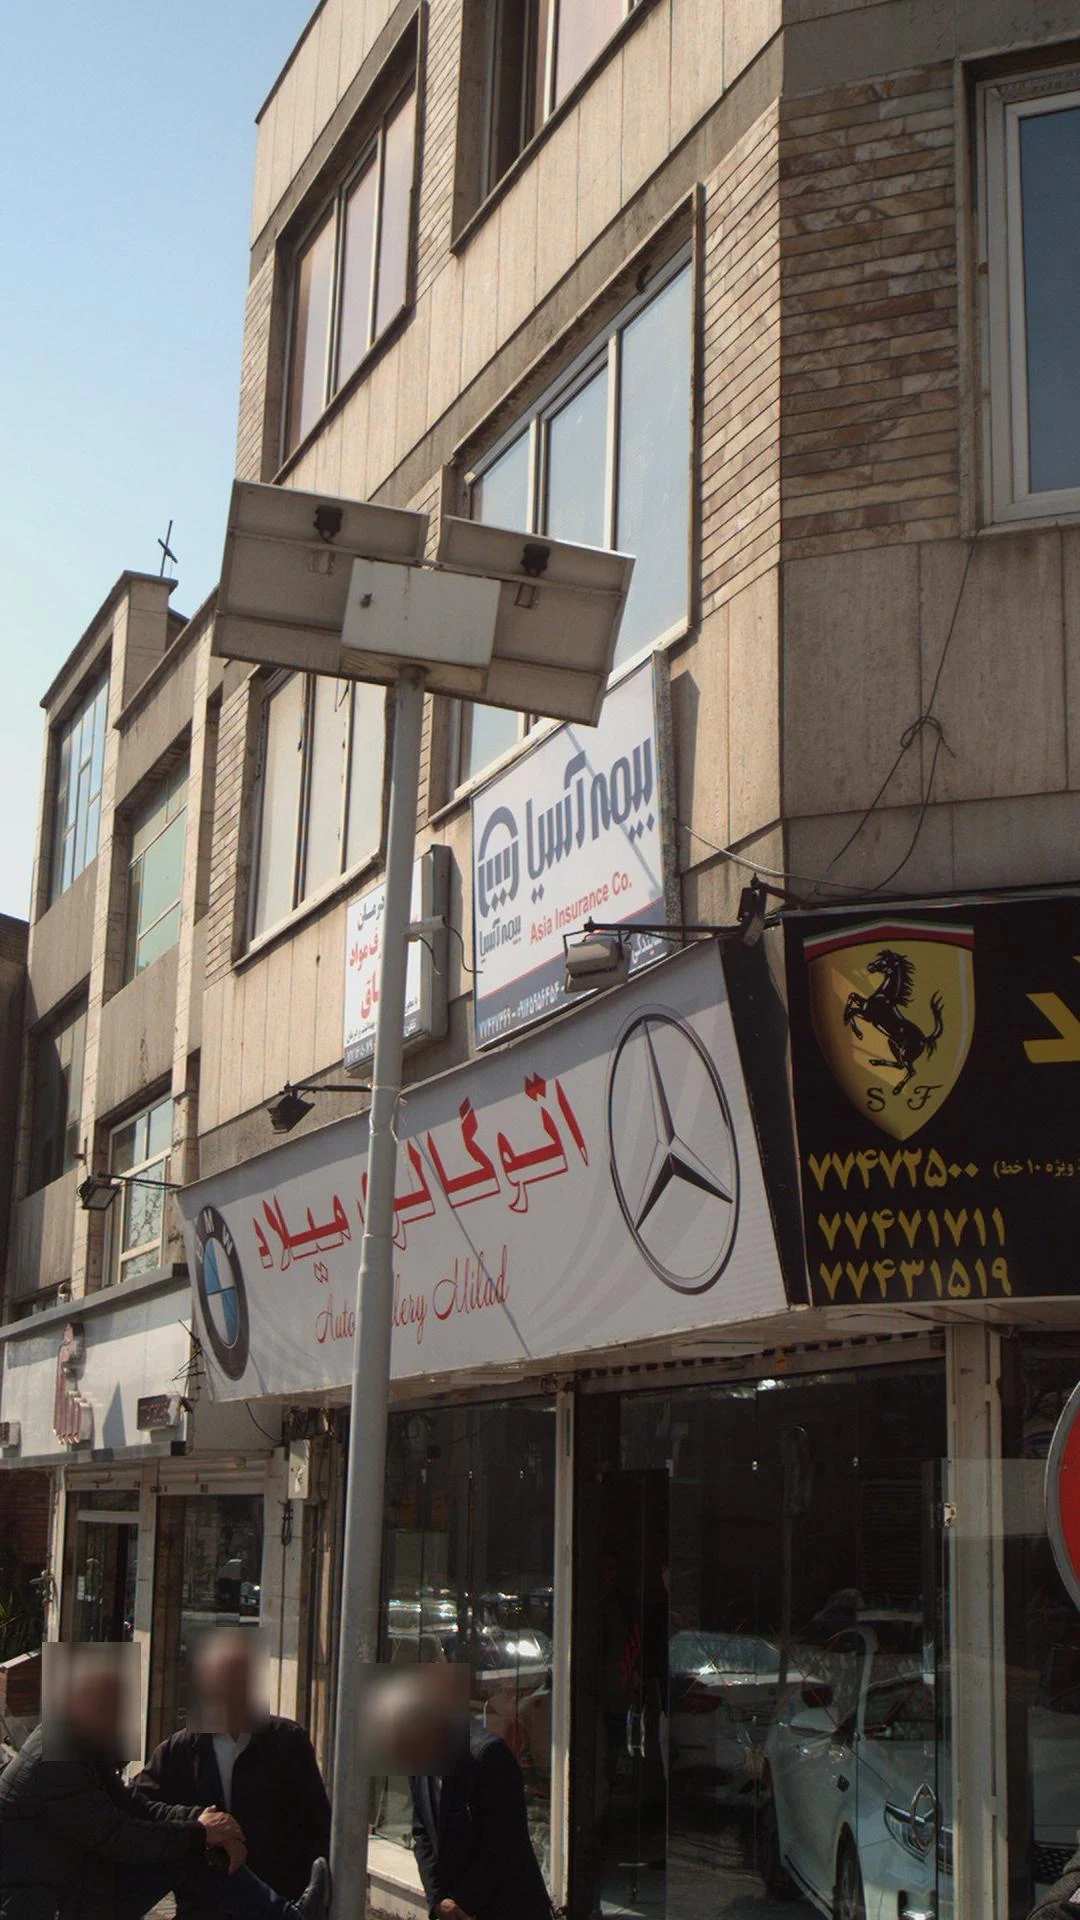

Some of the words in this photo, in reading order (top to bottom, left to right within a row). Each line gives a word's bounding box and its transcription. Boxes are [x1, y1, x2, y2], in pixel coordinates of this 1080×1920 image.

[525, 750, 587, 904] آسیا
[590, 737, 655, 843] بیمه
[530, 915, 553, 945] Asia
[555, 884, 610, 930] Insurance
[611, 871, 633, 896] Co.
[808, 1148, 979, 1191] ۷۷۴۷۲۵۰۰
[252, 1193, 352, 1284] میلاد
[818, 1207, 1006, 1250] ۷۷۴۷۱۷۱۱
[432, 1244, 511, 1320] Milad
[819, 1257, 1012, 1300] ۷۷۴۳۱۵۱۹
